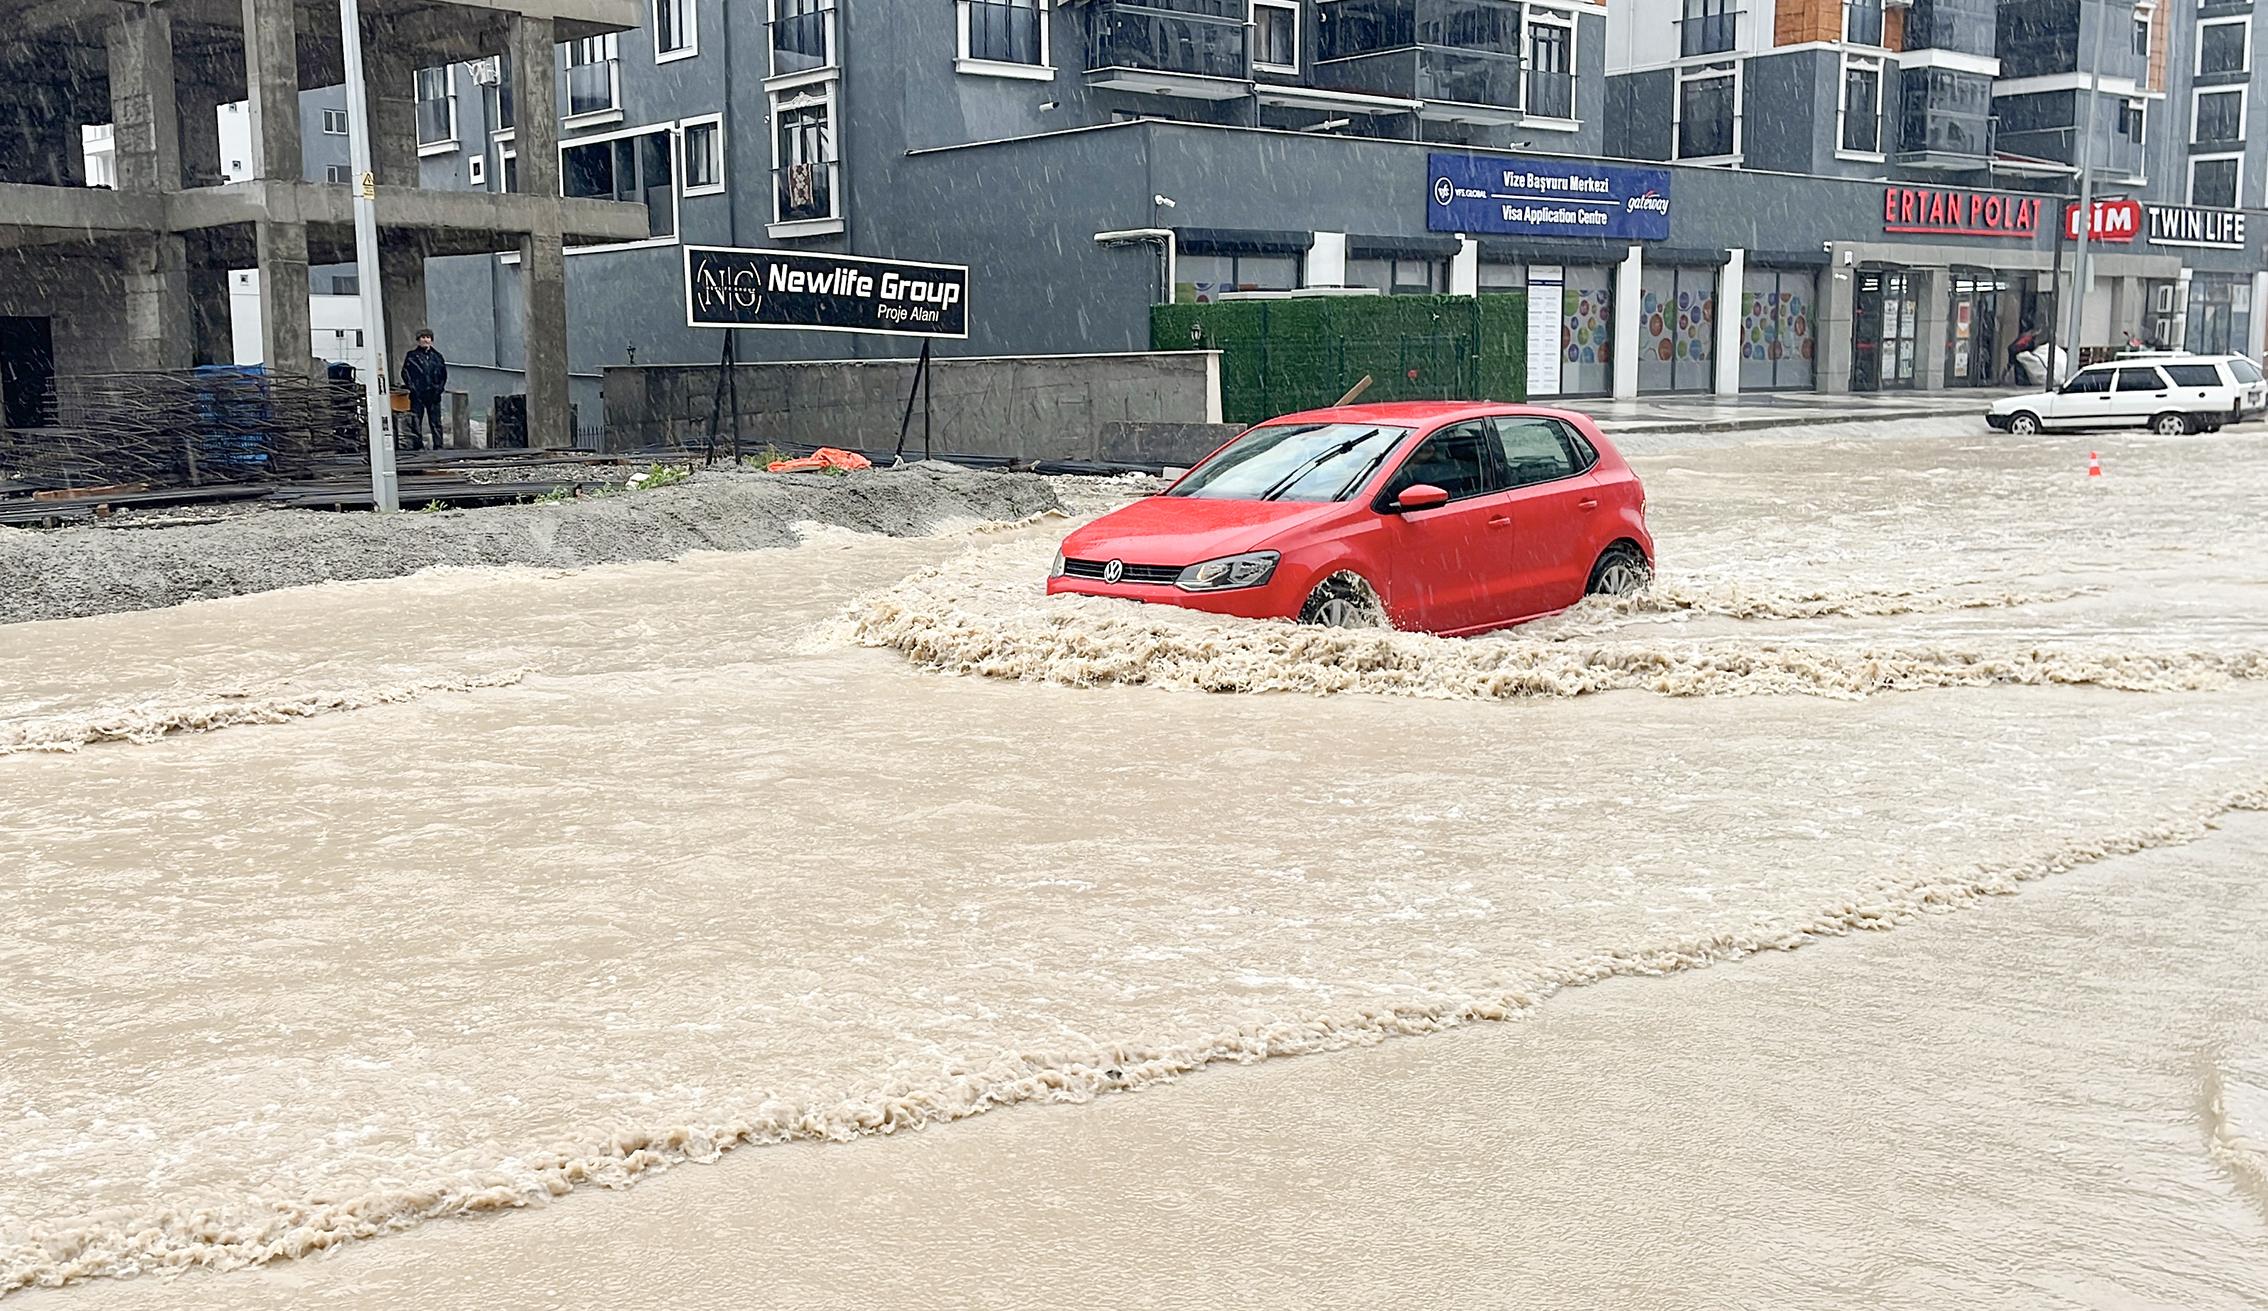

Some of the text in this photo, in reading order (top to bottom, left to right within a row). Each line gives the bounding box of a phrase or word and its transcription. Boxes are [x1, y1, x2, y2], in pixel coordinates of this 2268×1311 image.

[1503, 170, 1609, 193] Vize Başvuru Merkezi
[1502, 204, 1608, 225] Visa Application Centre
[1626, 194, 1669, 216] gateway
[1885, 187, 2041, 229] ERTAN POLAT
[2148, 207, 2246, 242] TWIN LIFE
[768, 263, 960, 311] Newlife Group
[877, 303, 940, 323] Proje Alanı
